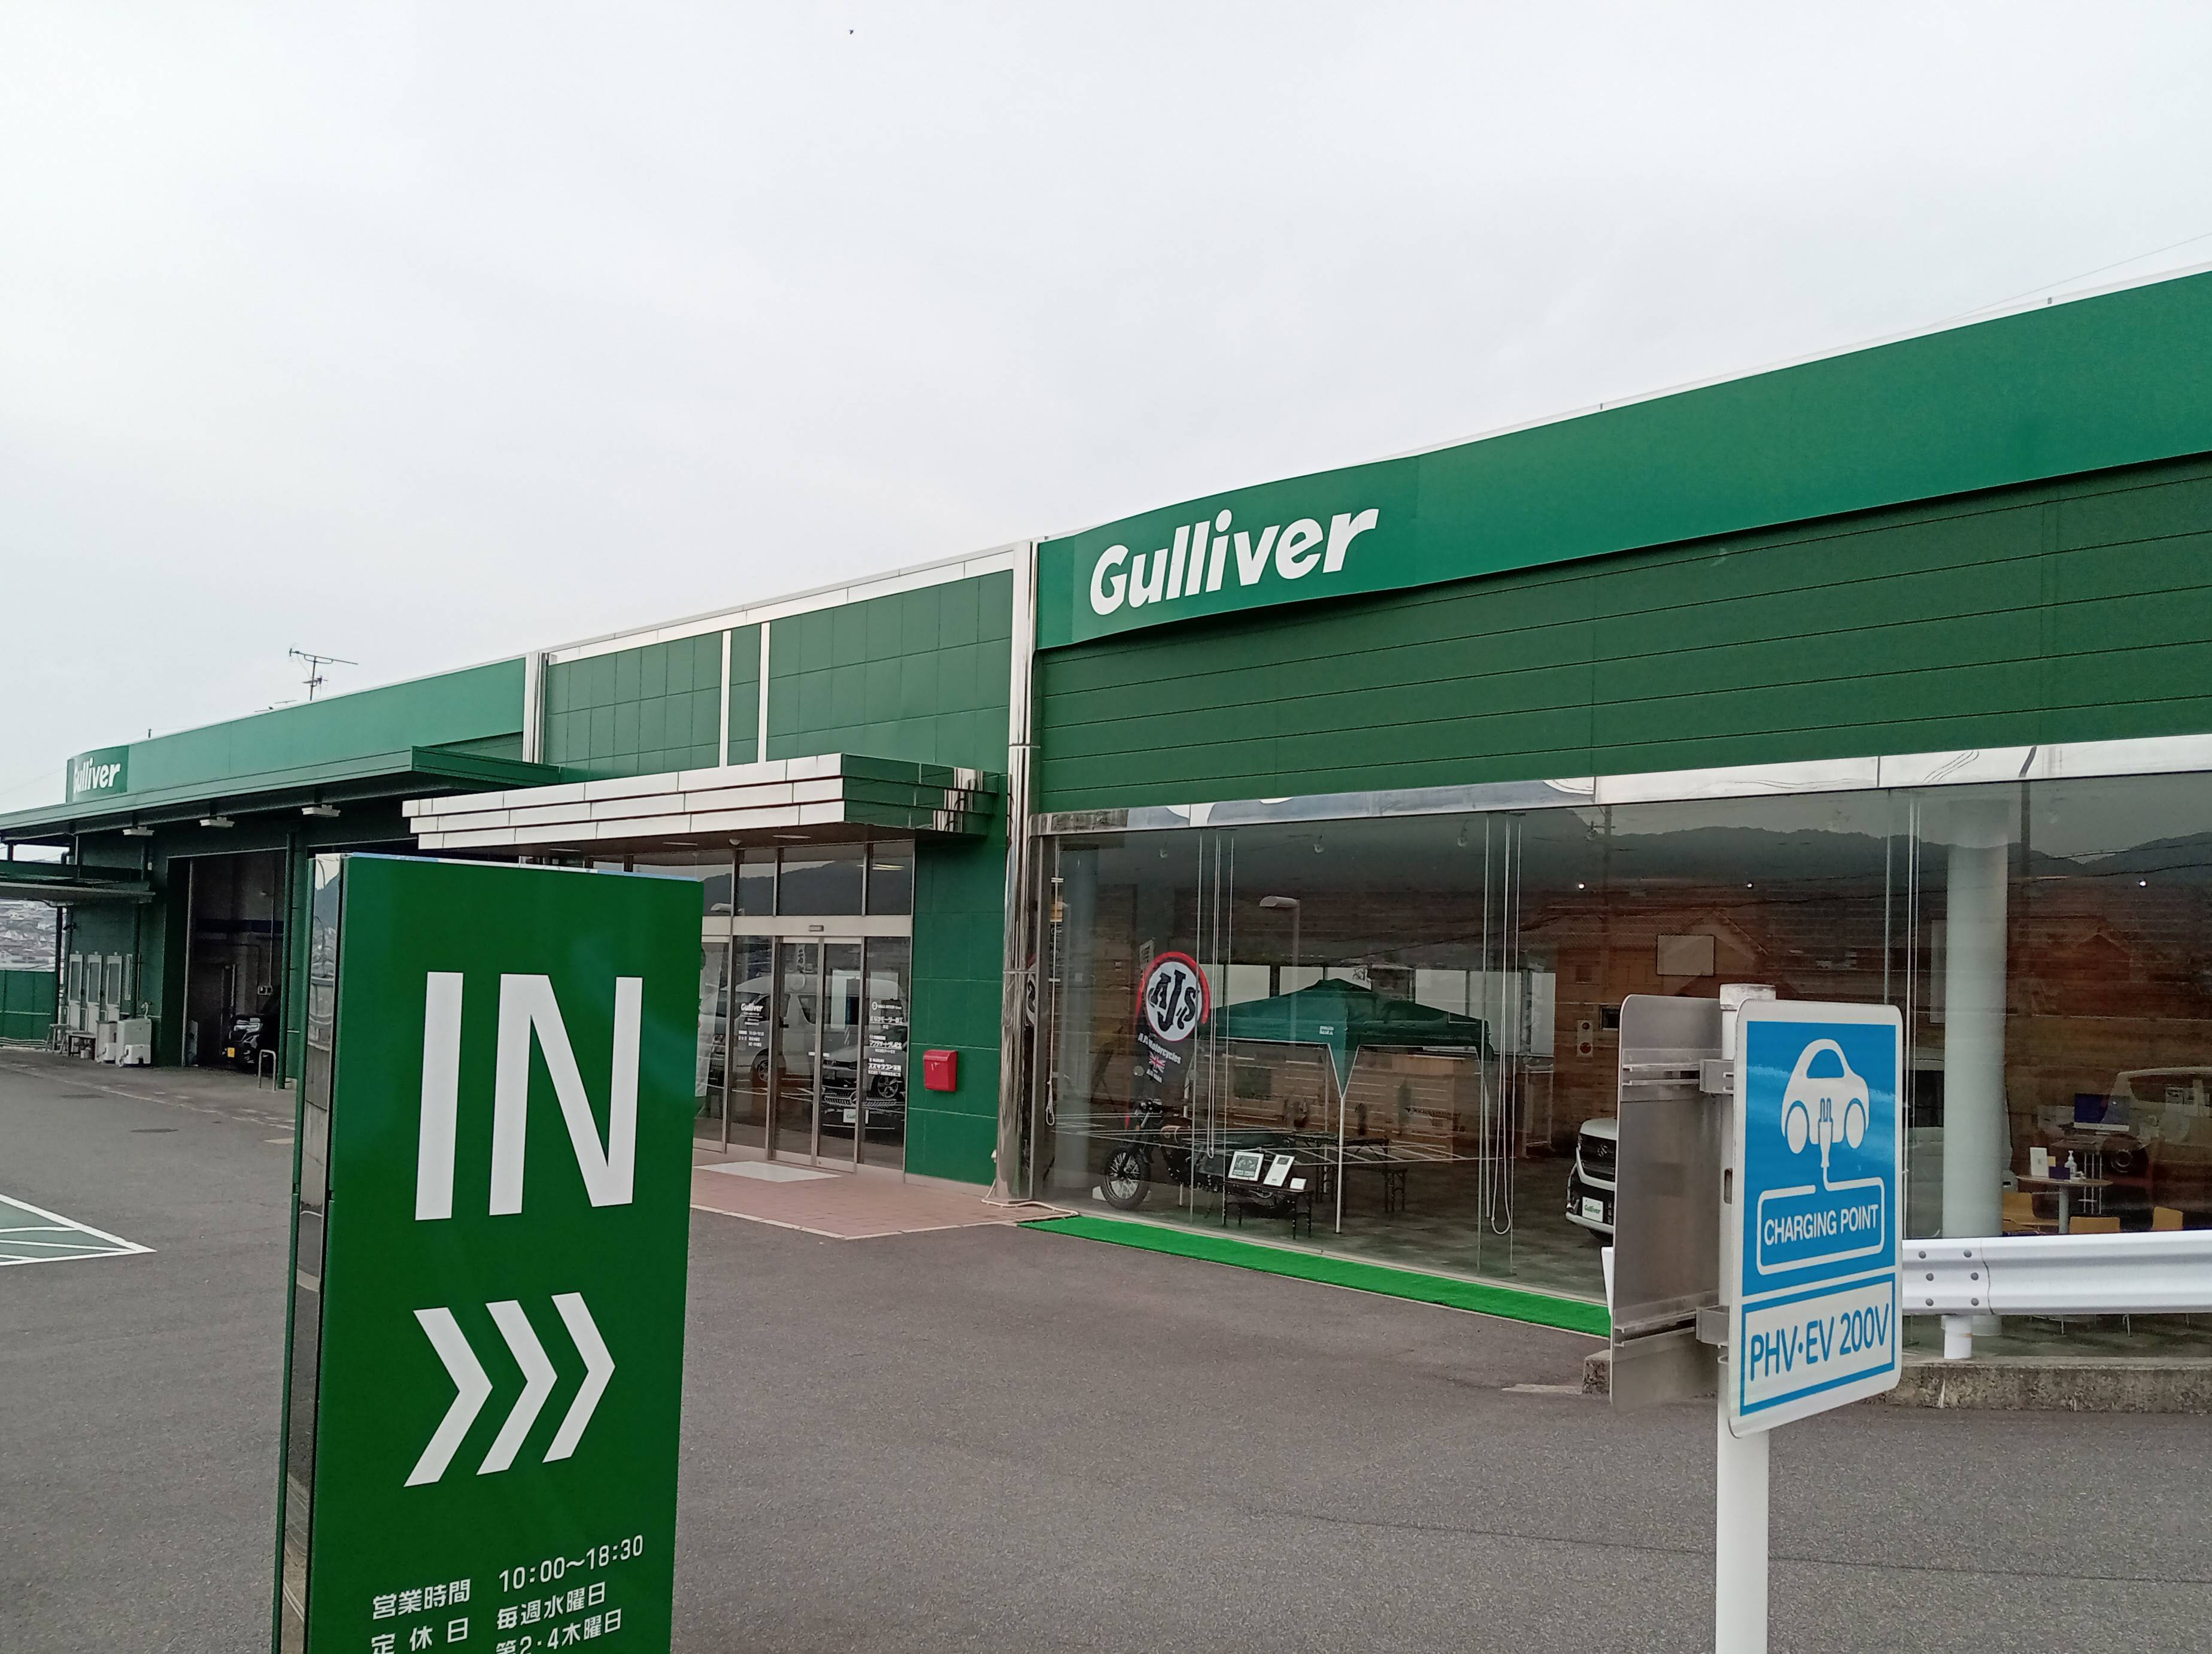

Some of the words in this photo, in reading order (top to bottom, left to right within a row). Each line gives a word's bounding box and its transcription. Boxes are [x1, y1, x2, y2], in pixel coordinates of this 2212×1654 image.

[1090, 508, 1379, 616] Gulliver
[1148, 969, 1199, 1032] AJS
[415, 971, 643, 1221] IN
[1764, 1210, 1837, 1246] CHARGING
[1840, 1204, 1879, 1234] POINT
[1840, 1303, 1889, 1356] 200V
[372, 1578, 471, 1620] 営業時間
[496, 1581, 606, 1631] 毎週水曜日
